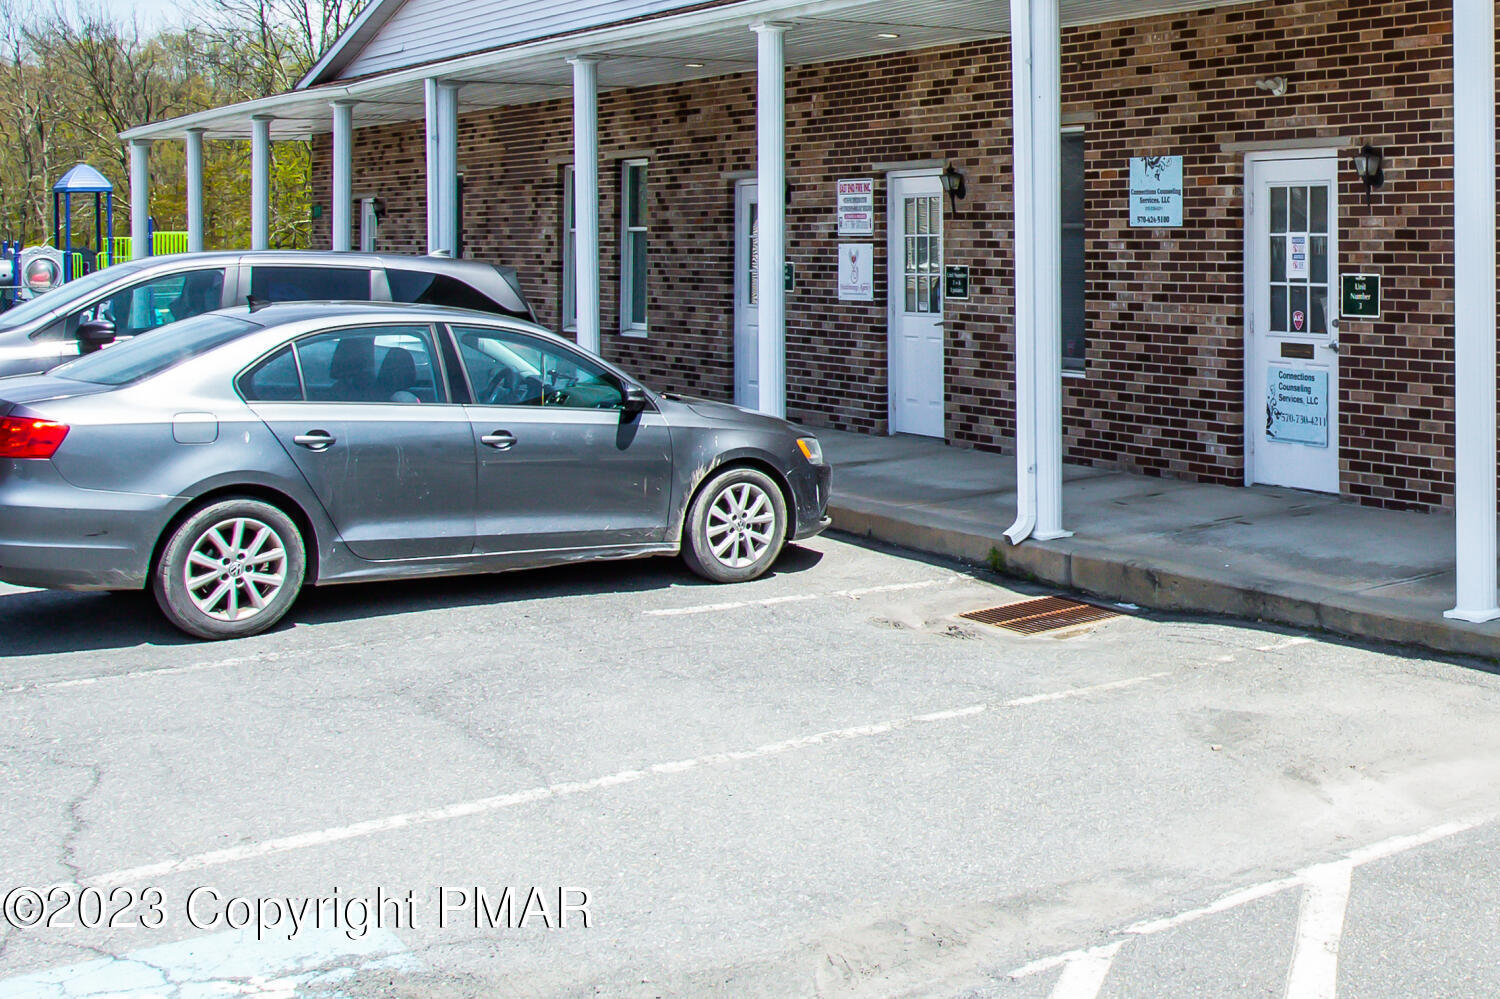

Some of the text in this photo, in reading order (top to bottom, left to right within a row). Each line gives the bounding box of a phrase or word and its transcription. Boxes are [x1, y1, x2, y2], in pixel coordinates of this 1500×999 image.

[1157, 188, 1181, 196] Counseling
[1355, 282, 1366, 290] Unit
[1350, 292, 1371, 300] Number
[1278, 370, 1315, 382] Connections
[1278, 382, 1312, 395] Counseling
[1278, 393, 1319, 405] Services, LLC
